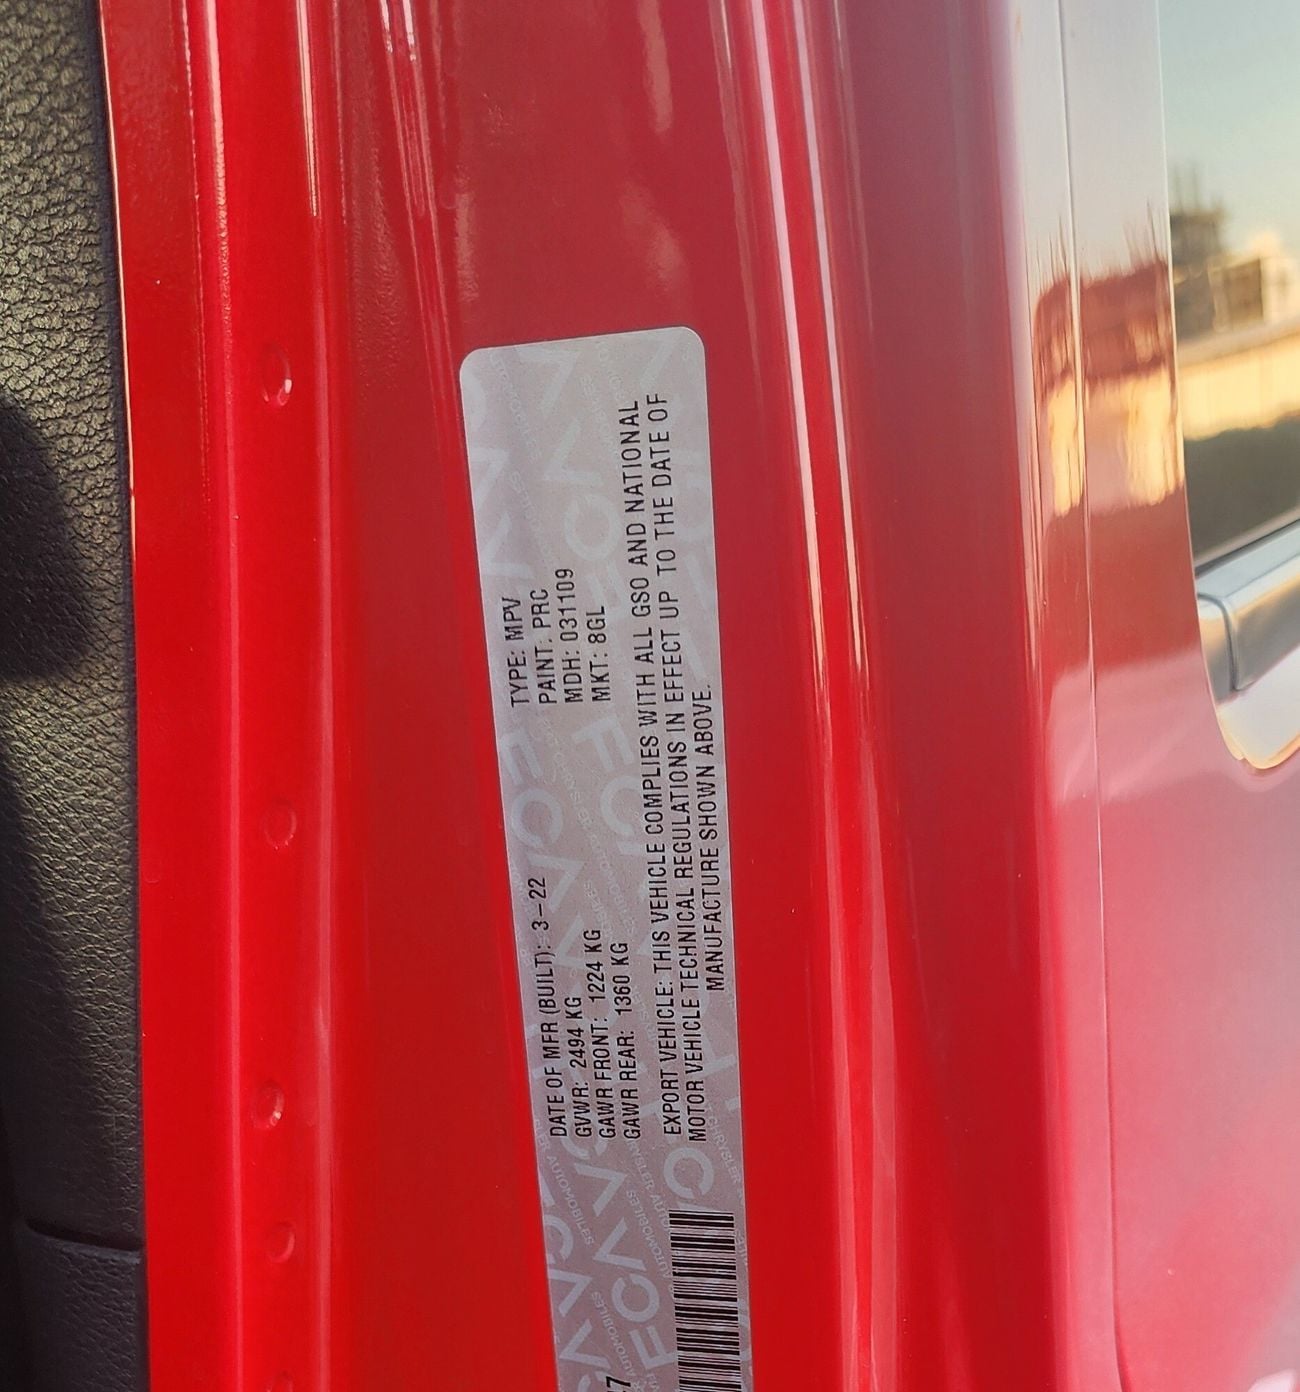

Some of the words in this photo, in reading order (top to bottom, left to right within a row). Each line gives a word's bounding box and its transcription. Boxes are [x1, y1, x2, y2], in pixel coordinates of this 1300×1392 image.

[646, 393, 668, 421] OF
[617, 400, 644, 513] NATIONAL
[648, 431, 672, 486] DATE
[625, 522, 648, 566] AND
[652, 497, 674, 540] THE
[655, 549, 676, 574] TO
[501, 596, 526, 641] MPV
[529, 589, 551, 629] PRC
[555, 568, 579, 642] 031109
[629, 577, 651, 618] GSO
[657, 591, 679, 619] UP
[585, 605, 607, 644] 8GL
[631, 627, 653, 664] ALL
[506, 650, 530, 707] TYPE:
[561, 650, 584, 703] MDH:
[589, 652, 611, 702] MKT:
[659, 629, 683, 702] EFFECT
[634, 673, 659, 727] WITH
[662, 712, 685, 732] IN
[690, 684, 715, 756] ABOVE.
[638, 735, 665, 835] COMPLIES
[663, 742, 693, 879] REGULATIONS
[696, 765, 718, 840] SHOWN
[646, 843, 669, 923] VEHICLE
[583, 929, 602, 953] KG
[674, 887, 699, 991] TECHNICAL
[699, 848, 725, 991] MANUFACTURE
[609, 942, 629, 966] KG
[652, 930, 672, 974] THIS
[534, 945, 560, 1014] (BUILT):
[586, 961, 605, 1003] 1224
[612, 975, 632, 1016] 1360
[564, 996, 583, 1020] KG
[655, 981, 678, 1062] VEHICLE:
[540, 1022, 561, 1058] MFR
[567, 1028, 586, 1068] 2494
[590, 1018, 612, 1081] FRONT:
[616, 1030, 637, 1081] REAR:
[680, 999, 703, 1074] VEHICLE
[544, 1067, 564, 1088] OF
[659, 1070, 681, 1135] EXPORT
[547, 1094, 568, 1137] DATE
[572, 1082, 593, 1138] GVWR:
[596, 1087, 616, 1139] GAWR
[620, 1089, 641, 1140] GAWR
[683, 1080, 707, 1142] MOTOR
